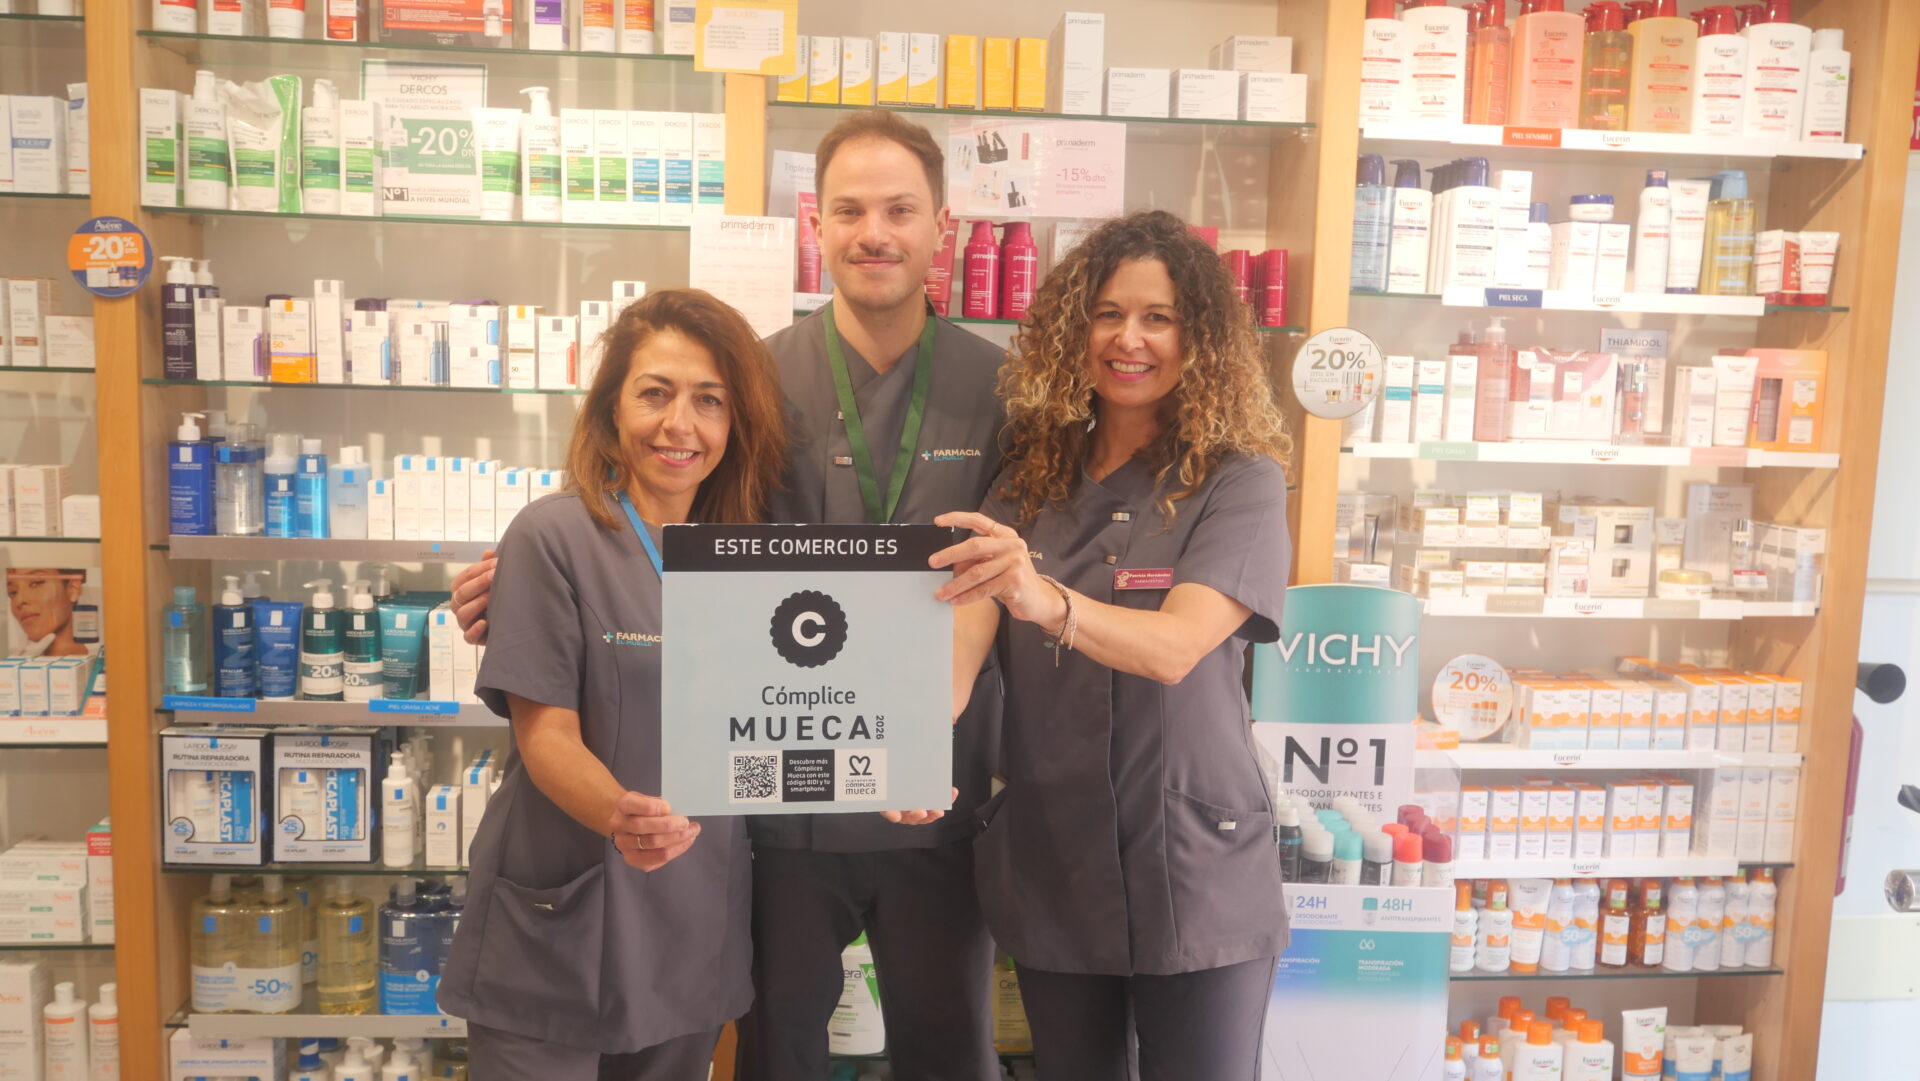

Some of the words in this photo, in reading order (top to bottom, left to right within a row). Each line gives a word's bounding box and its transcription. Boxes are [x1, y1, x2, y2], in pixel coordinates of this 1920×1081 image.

[1068, 17, 1102, 26] primaderm
[1770, 38, 1794, 47] Eucerin
[400, 84, 448, 96] DERCOS
[410, 127, 476, 156] -20%
[1056, 138, 1096, 148] primaderm
[1602, 134, 1630, 144] Eucerin
[1056, 167, 1090, 182] -15%
[438, 197, 471, 205] MUNDIAL
[720, 220, 774, 231] primaderm
[83, 236, 136, 261] -20%
[1513, 294, 1528, 302] SECA
[1592, 294, 1620, 304] Eucerin
[1607, 337, 1662, 348] THIAMIDOL
[1310, 348, 1366, 370] 20%
[933, 448, 981, 457] FARMACIA
[1591, 448, 1619, 457] Eucerin
[714, 538, 762, 555] ESTE
[768, 538, 868, 555] COMERCIO
[875, 538, 898, 555] ES
[1574, 602, 1602, 612] Eucerin
[792, 610, 826, 647] C
[1277, 632, 1416, 668] VICHY
[310, 666, 340, 678] -20%
[1449, 670, 1498, 693] 20%
[762, 686, 856, 710] Cómplice
[730, 715, 872, 742] MUECA
[876, 715, 884, 740] 2026
[1553, 753, 1582, 762] Eucerin
[1378, 790, 1384, 800] E
[284, 822, 298, 832] 25
[1573, 862, 1600, 872] Eucerin
[1296, 896, 1327, 909] 24H
[1382, 898, 1412, 912] 48H
[1562, 926, 1580, 942] 50
[1684, 927, 1704, 943] 50
[1735, 925, 1751, 940] 50
[842, 968, 876, 979] eraVe
[248, 978, 293, 994] -50%
